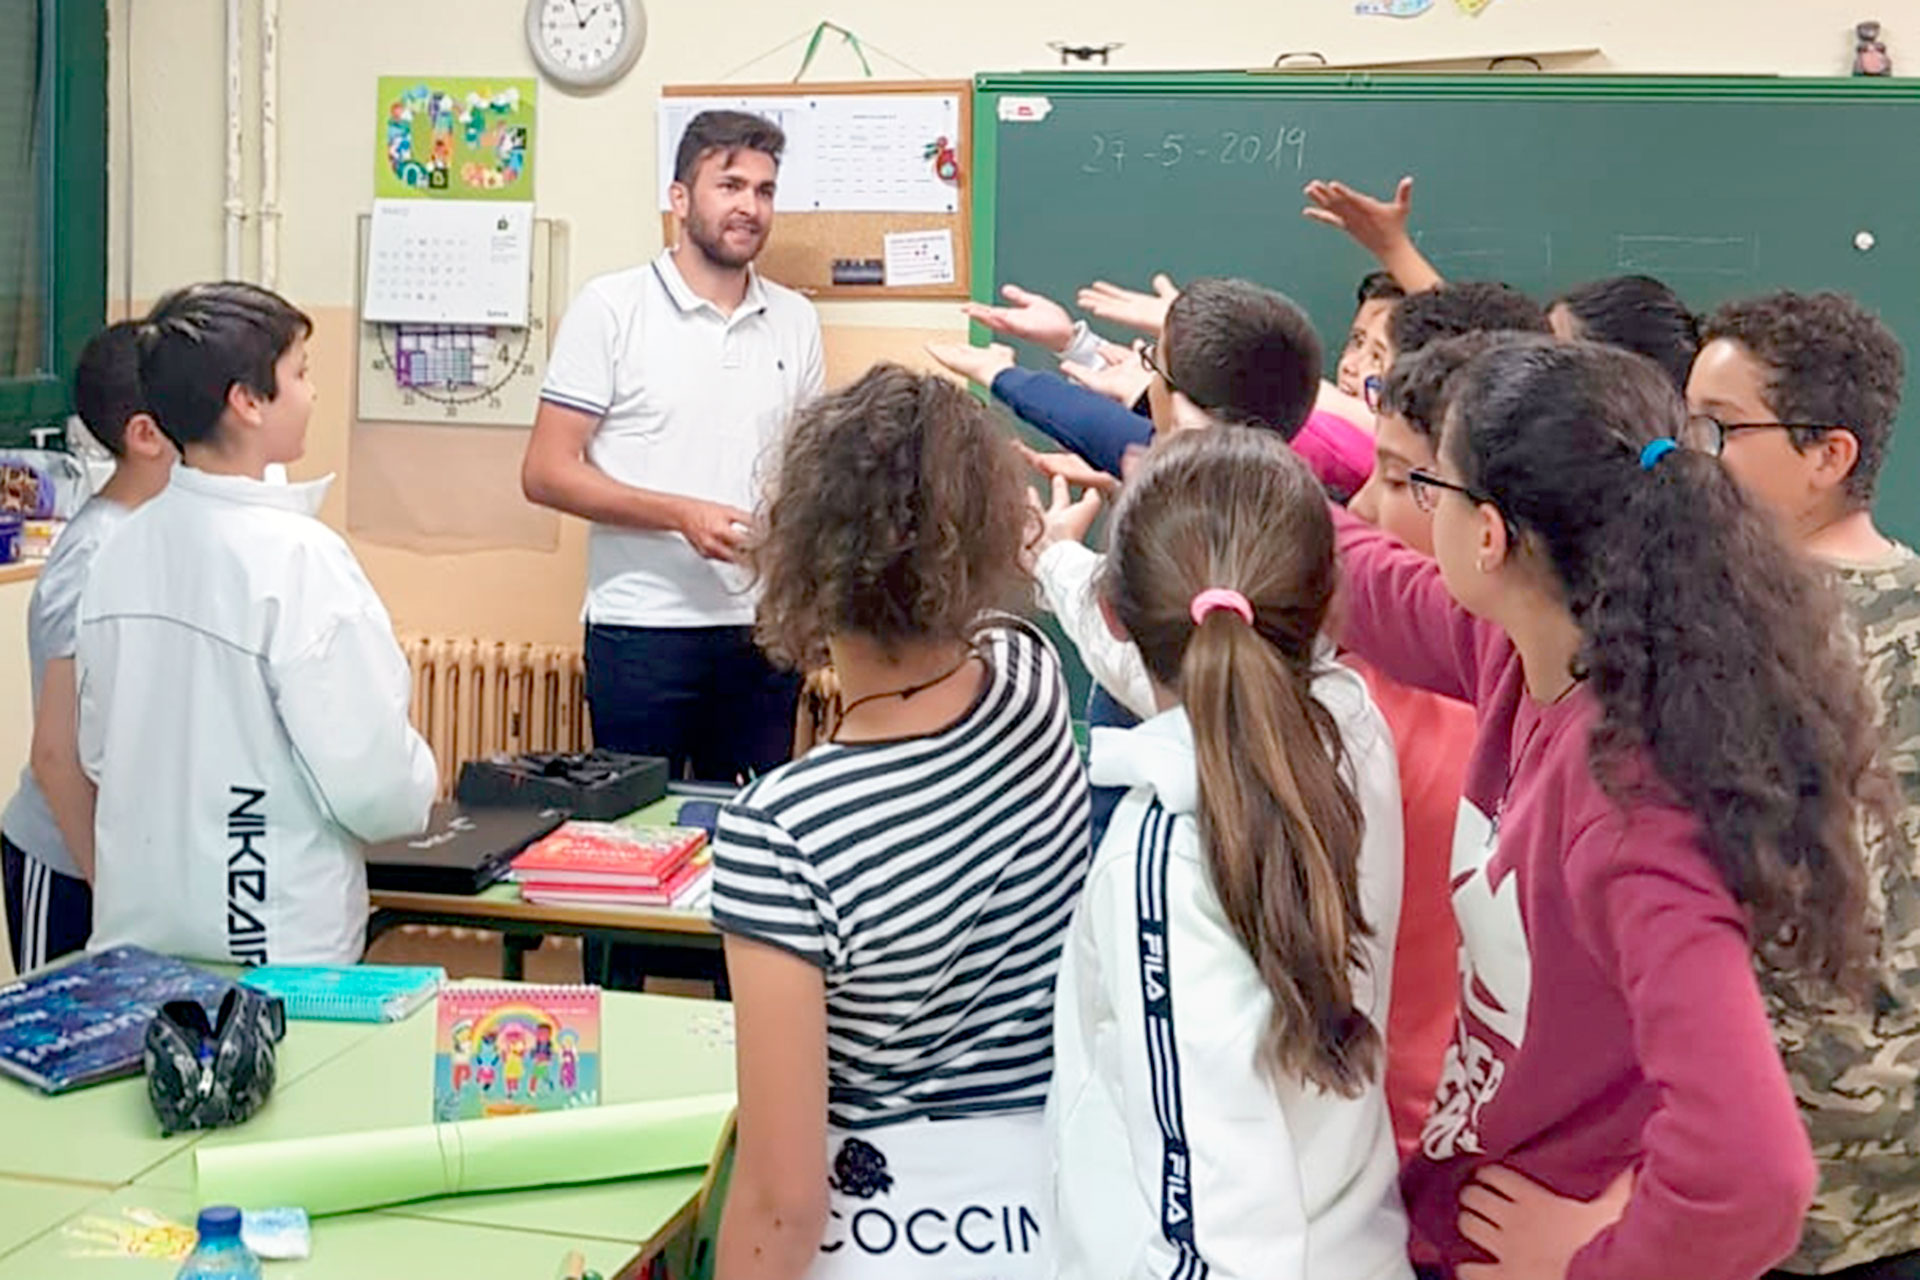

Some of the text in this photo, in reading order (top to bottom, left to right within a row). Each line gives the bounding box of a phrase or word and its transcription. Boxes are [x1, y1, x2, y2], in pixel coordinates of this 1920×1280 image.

[497, 344, 509, 366] 4
[1142, 932, 1167, 1002] FILA
[1167, 1151, 1189, 1225] FILA
